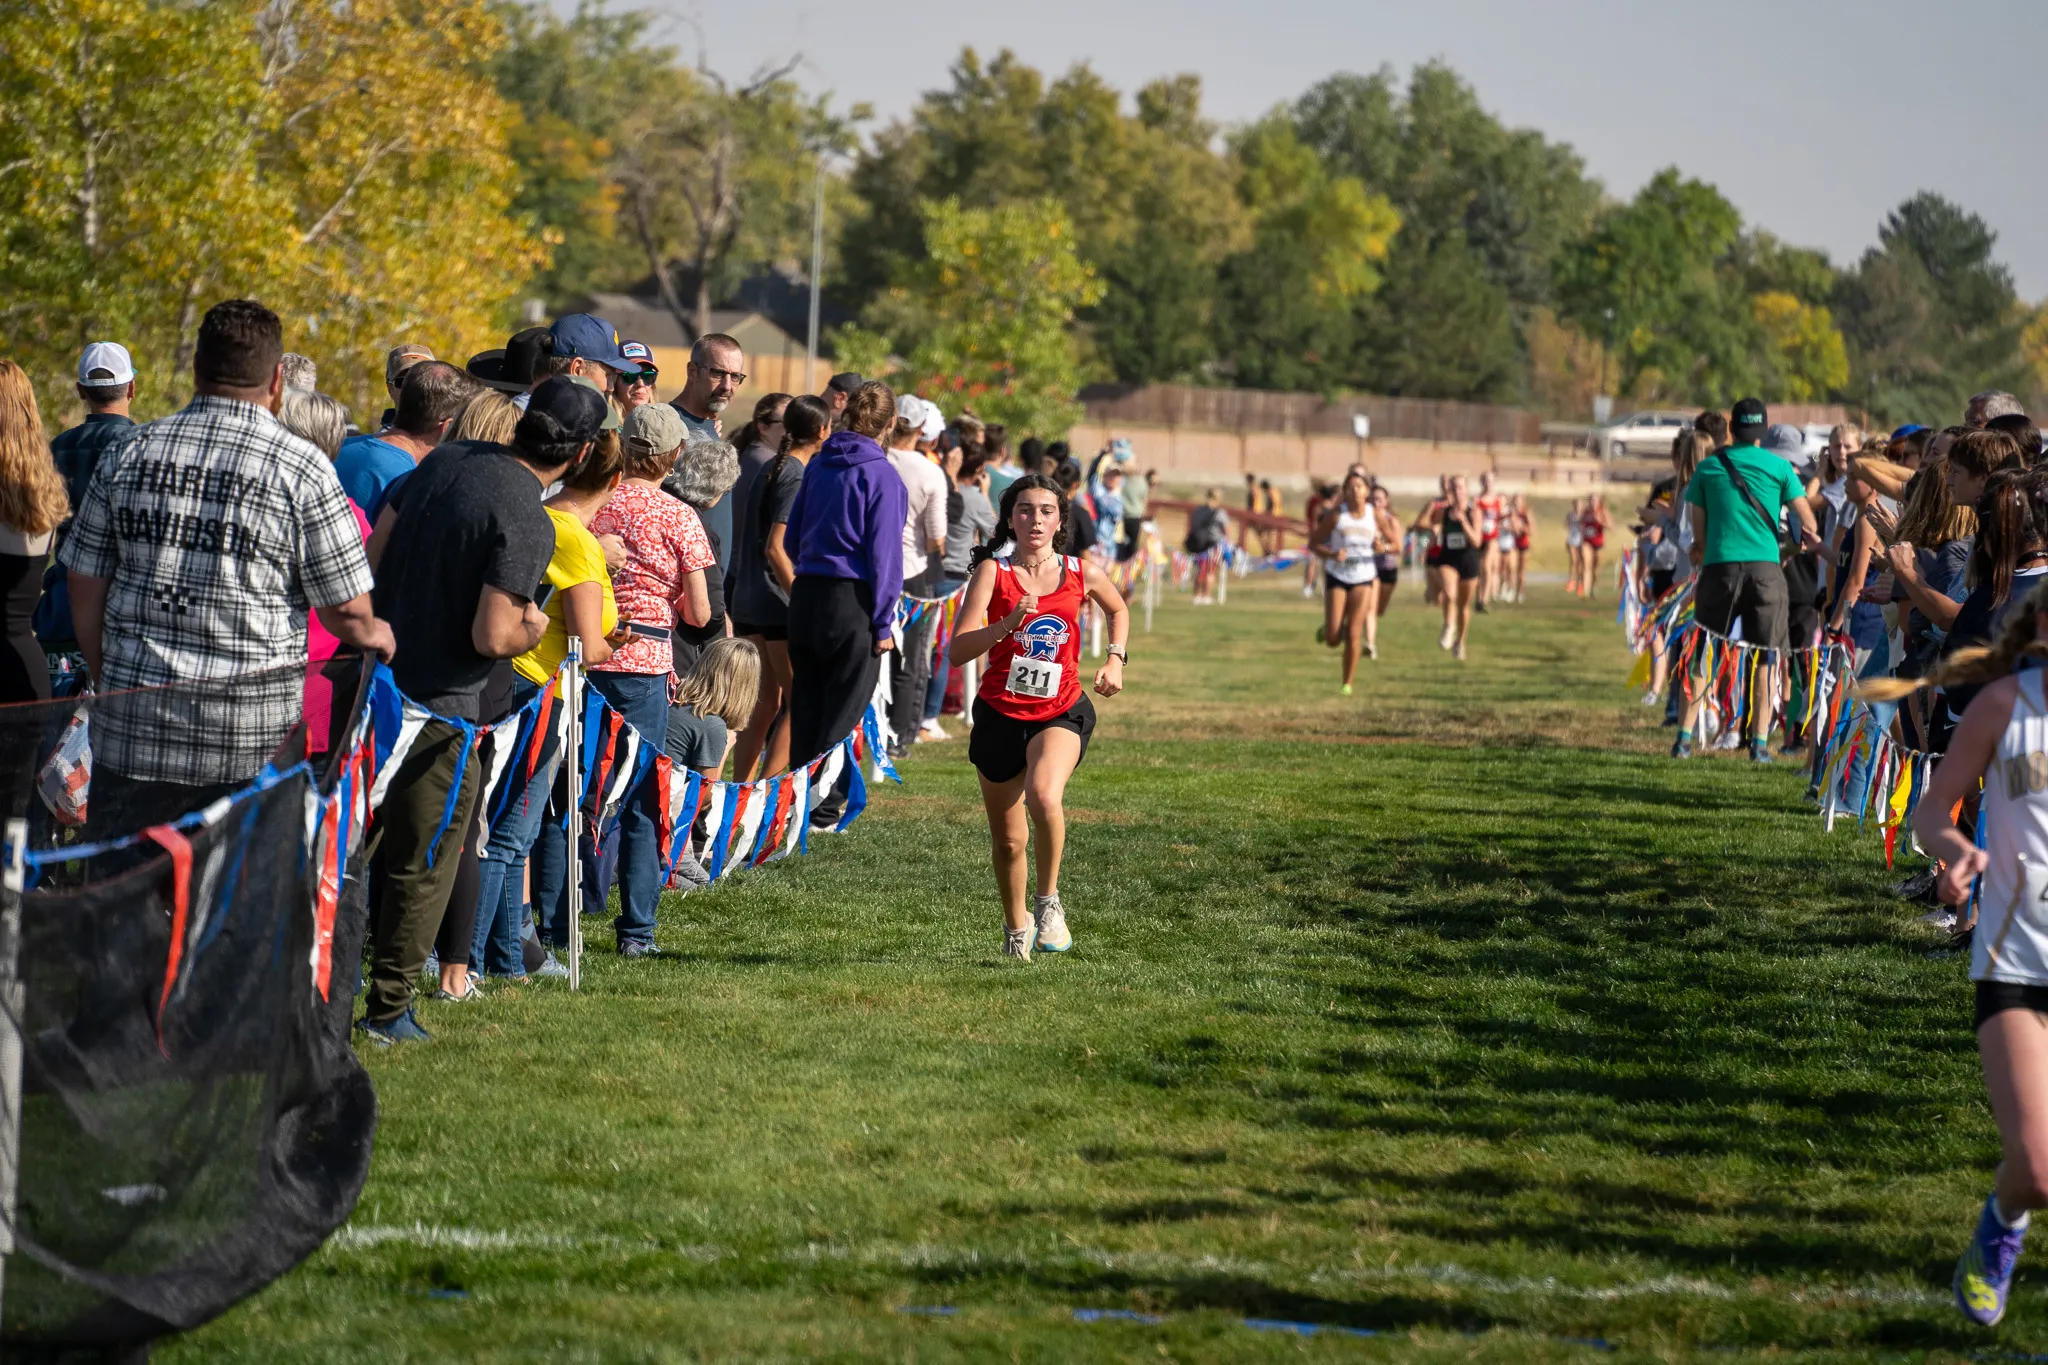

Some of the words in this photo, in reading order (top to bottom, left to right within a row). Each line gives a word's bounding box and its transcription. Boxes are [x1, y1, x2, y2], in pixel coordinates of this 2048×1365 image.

[137, 459, 257, 506] HARLEY
[118, 507, 261, 562] DAVIDSON
[1015, 666, 1051, 687] 211
